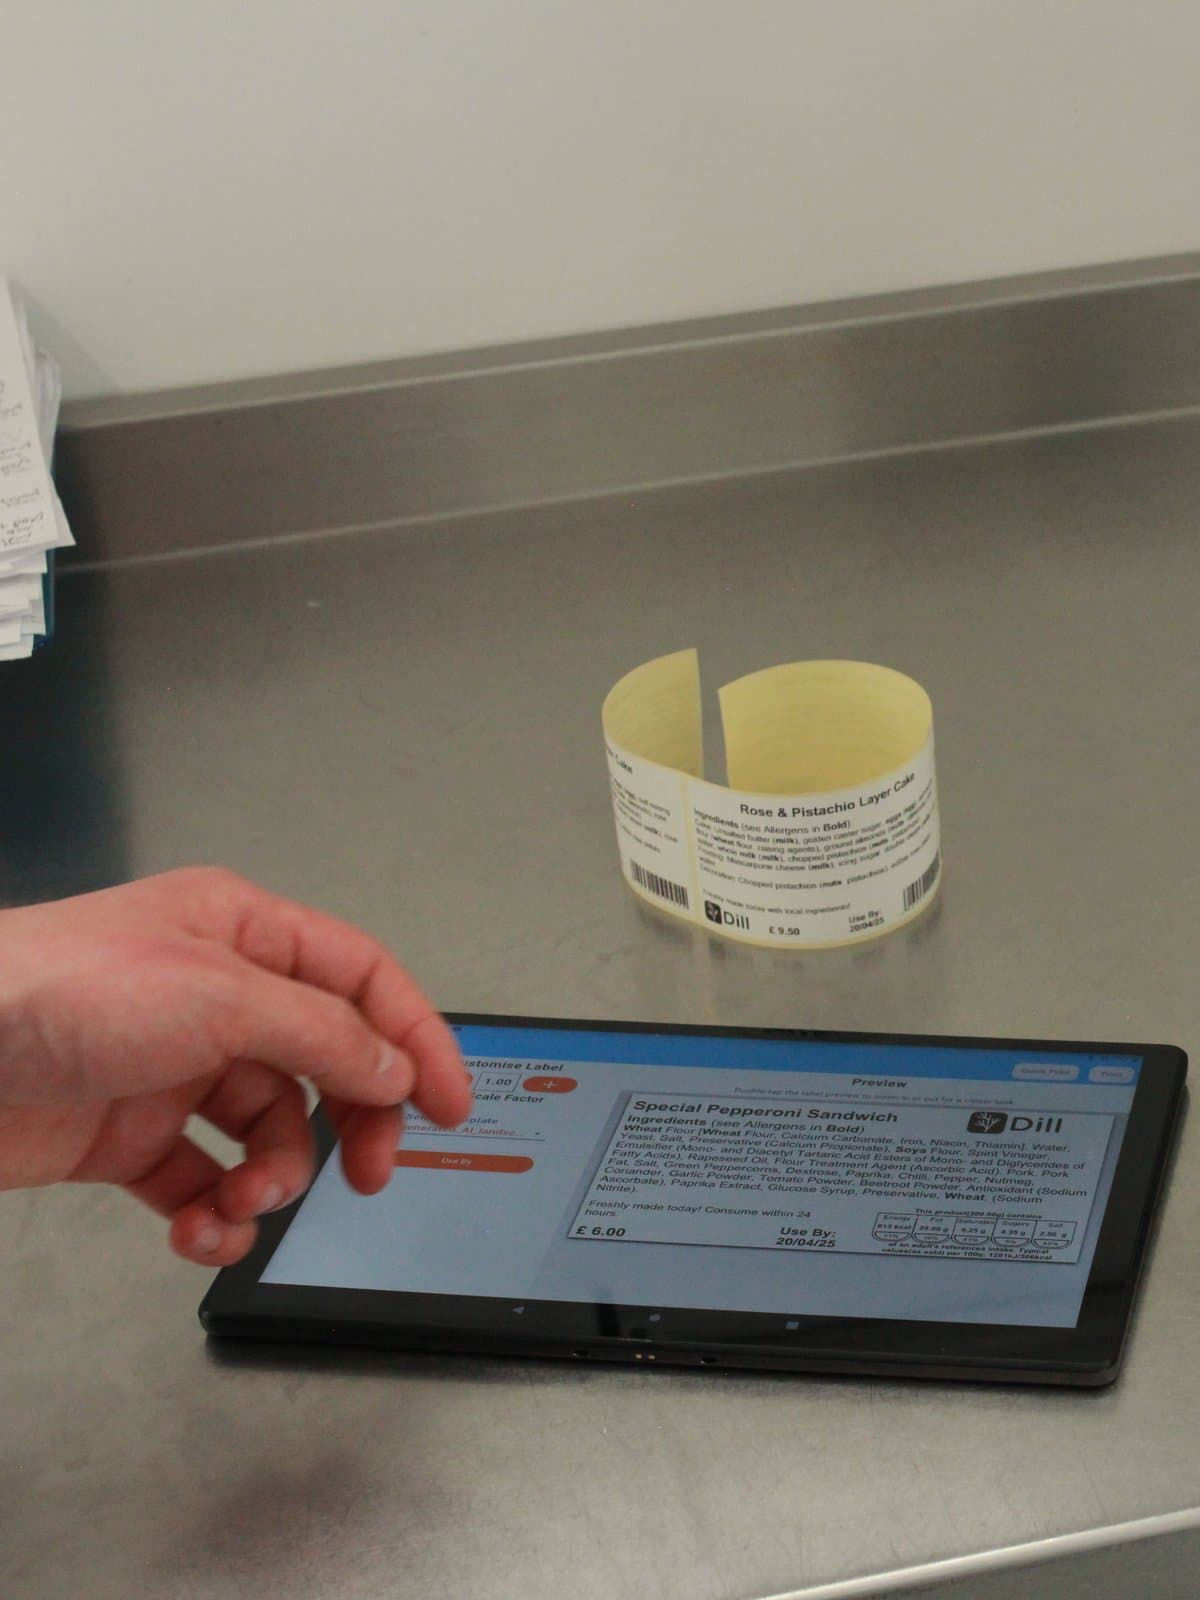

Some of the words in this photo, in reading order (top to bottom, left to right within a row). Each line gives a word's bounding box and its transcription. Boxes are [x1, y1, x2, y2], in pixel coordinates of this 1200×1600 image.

[740, 804, 773, 817] Rose
[778, 808, 787, 818] &
[792, 801, 855, 818] Pistachio
[860, 787, 891, 809] Layer
[894, 773, 914, 793] Cake
[694, 808, 739, 829] Ingredients
[764, 824, 809, 835] Allergens
[823, 820, 851, 832] Bold)
[723, 911, 750, 930] Dill
[778, 927, 800, 936] 9.50
[526, 1062, 563, 1072] Label
[485, 1078, 512, 1086] 1.00
[852, 1077, 908, 1088] Preview
[472, 1093, 500, 1101] cale
[504, 1095, 544, 1103] Factor
[632, 1100, 702, 1114] Special
[705, 1104, 802, 1119] Pepperoni
[806, 1108, 899, 1122] Sandwich
[626, 1115, 708, 1126] Ingredients
[710, 1119, 741, 1128] (see
[743, 1120, 807, 1131] Allergens
[824, 1123, 865, 1133] Bold)
[1009, 1116, 1062, 1132] Dill
[622, 1124, 663, 1133] Wheat
[664, 1126, 694, 1134] Flour
[780, 1132, 829, 1141] Calcium
[688, 1136, 762, 1146] Preservative
[764, 1139, 817, 1149] (Calcium
[894, 1145, 927, 1154] Soya
[967, 1149, 998, 1157] Spirit
[614, 1141, 673, 1150] Emulsifier
[746, 1147, 794, 1156] Diacetyl
[797, 1149, 841, 1158] Tartaric
[844, 1152, 871, 1160] Acid
[873, 1153, 911, 1161] Esters
[928, 1156, 968, 1164] Mono-
[970, 1157, 993, 1165] and
[996, 1159, 1069, 1169] Diglycerides
[1072, 1162, 1085, 1170] of
[586, 1200, 630, 1210] Freshly
[632, 1202, 664, 1210] made
[666, 1203, 702, 1214] today!
[703, 1206, 759, 1215] Consume
[575, 1226, 587, 1234] £
[590, 1226, 626, 1236] 6.00
[778, 1227, 808, 1235] Use
[810, 1228, 837, 1238] By:
[774, 1236, 837, 1247] 20/04/25
